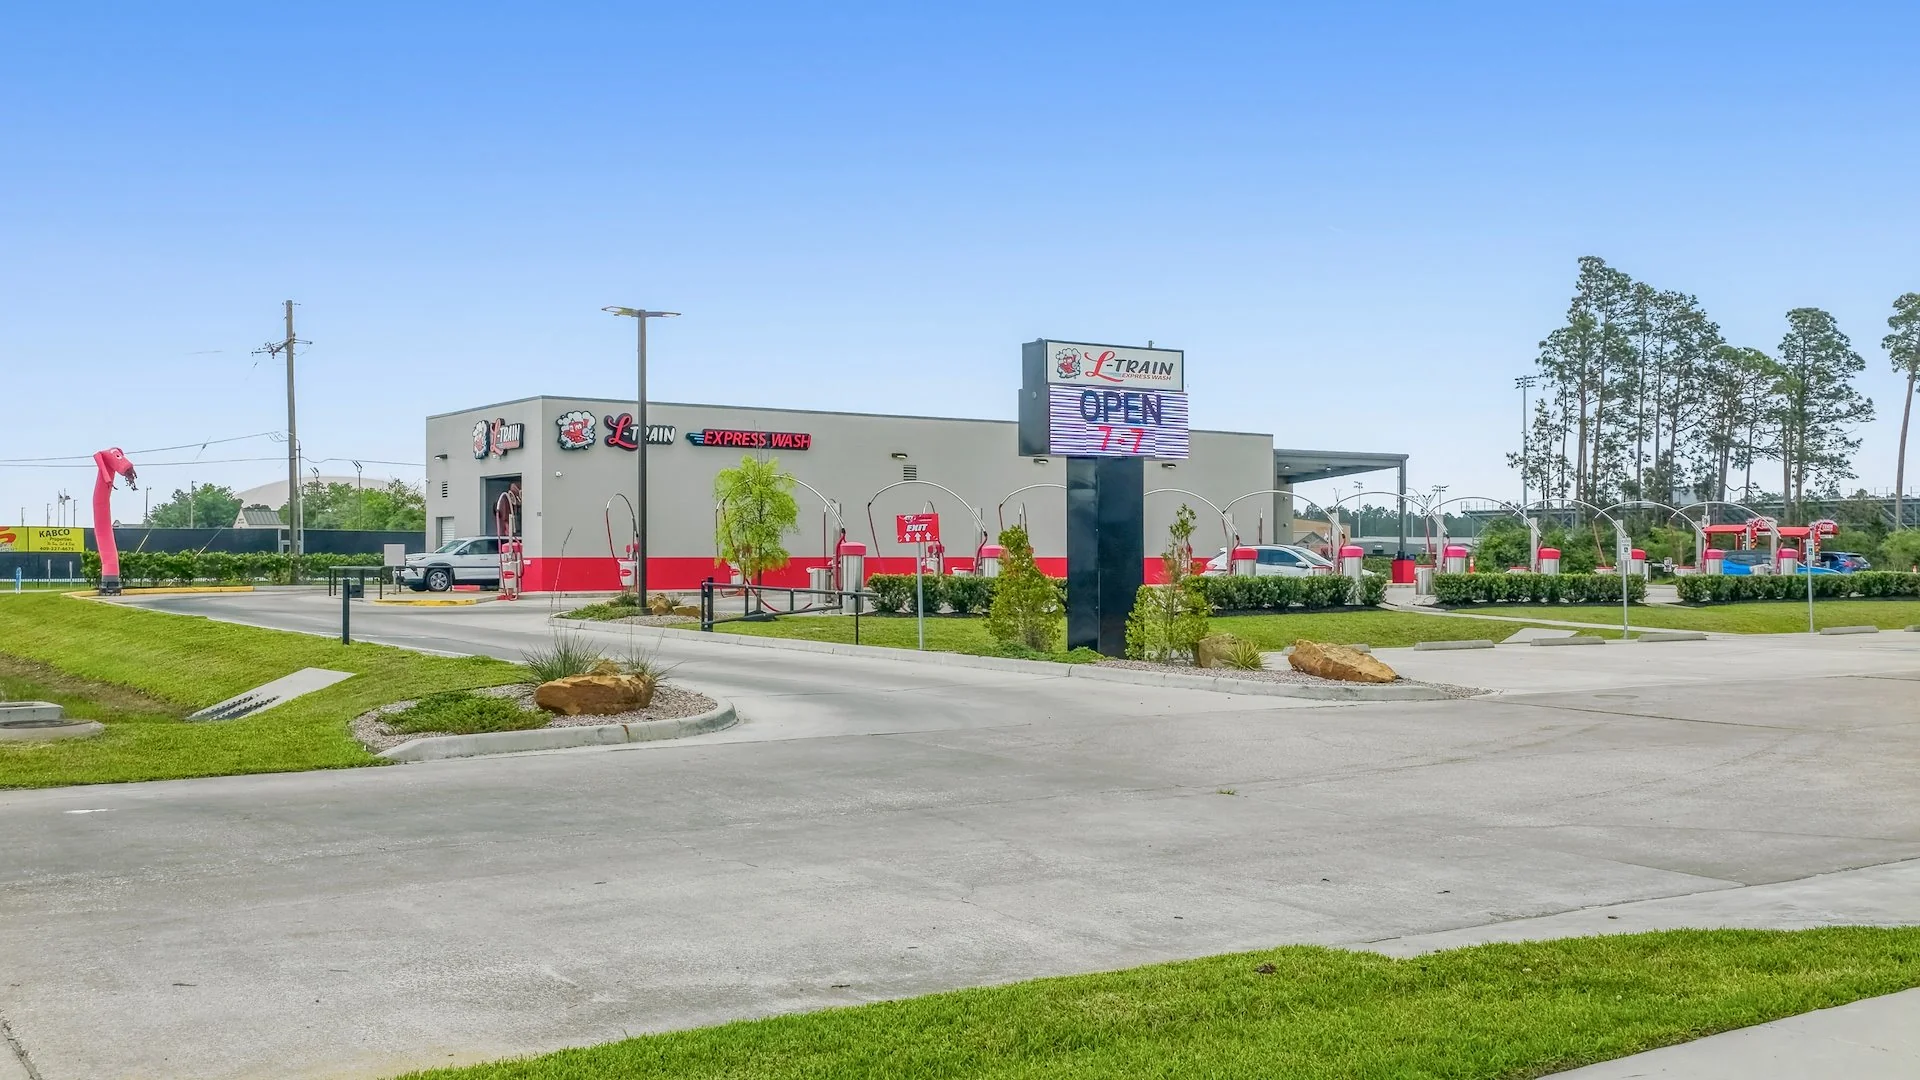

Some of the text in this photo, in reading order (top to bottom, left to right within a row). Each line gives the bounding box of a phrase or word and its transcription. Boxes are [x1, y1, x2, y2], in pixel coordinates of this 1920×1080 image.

[1084, 351, 1173, 382] L-TRAIN
[1080, 390, 1162, 425] OPEN
[490, 418, 520, 456] L-TRAIN
[704, 431, 812, 449] EXPRESS WASH
[1097, 426, 1144, 453] 7-7
[39, 528, 70, 538] KABCO
[906, 524, 928, 532] EXIT
